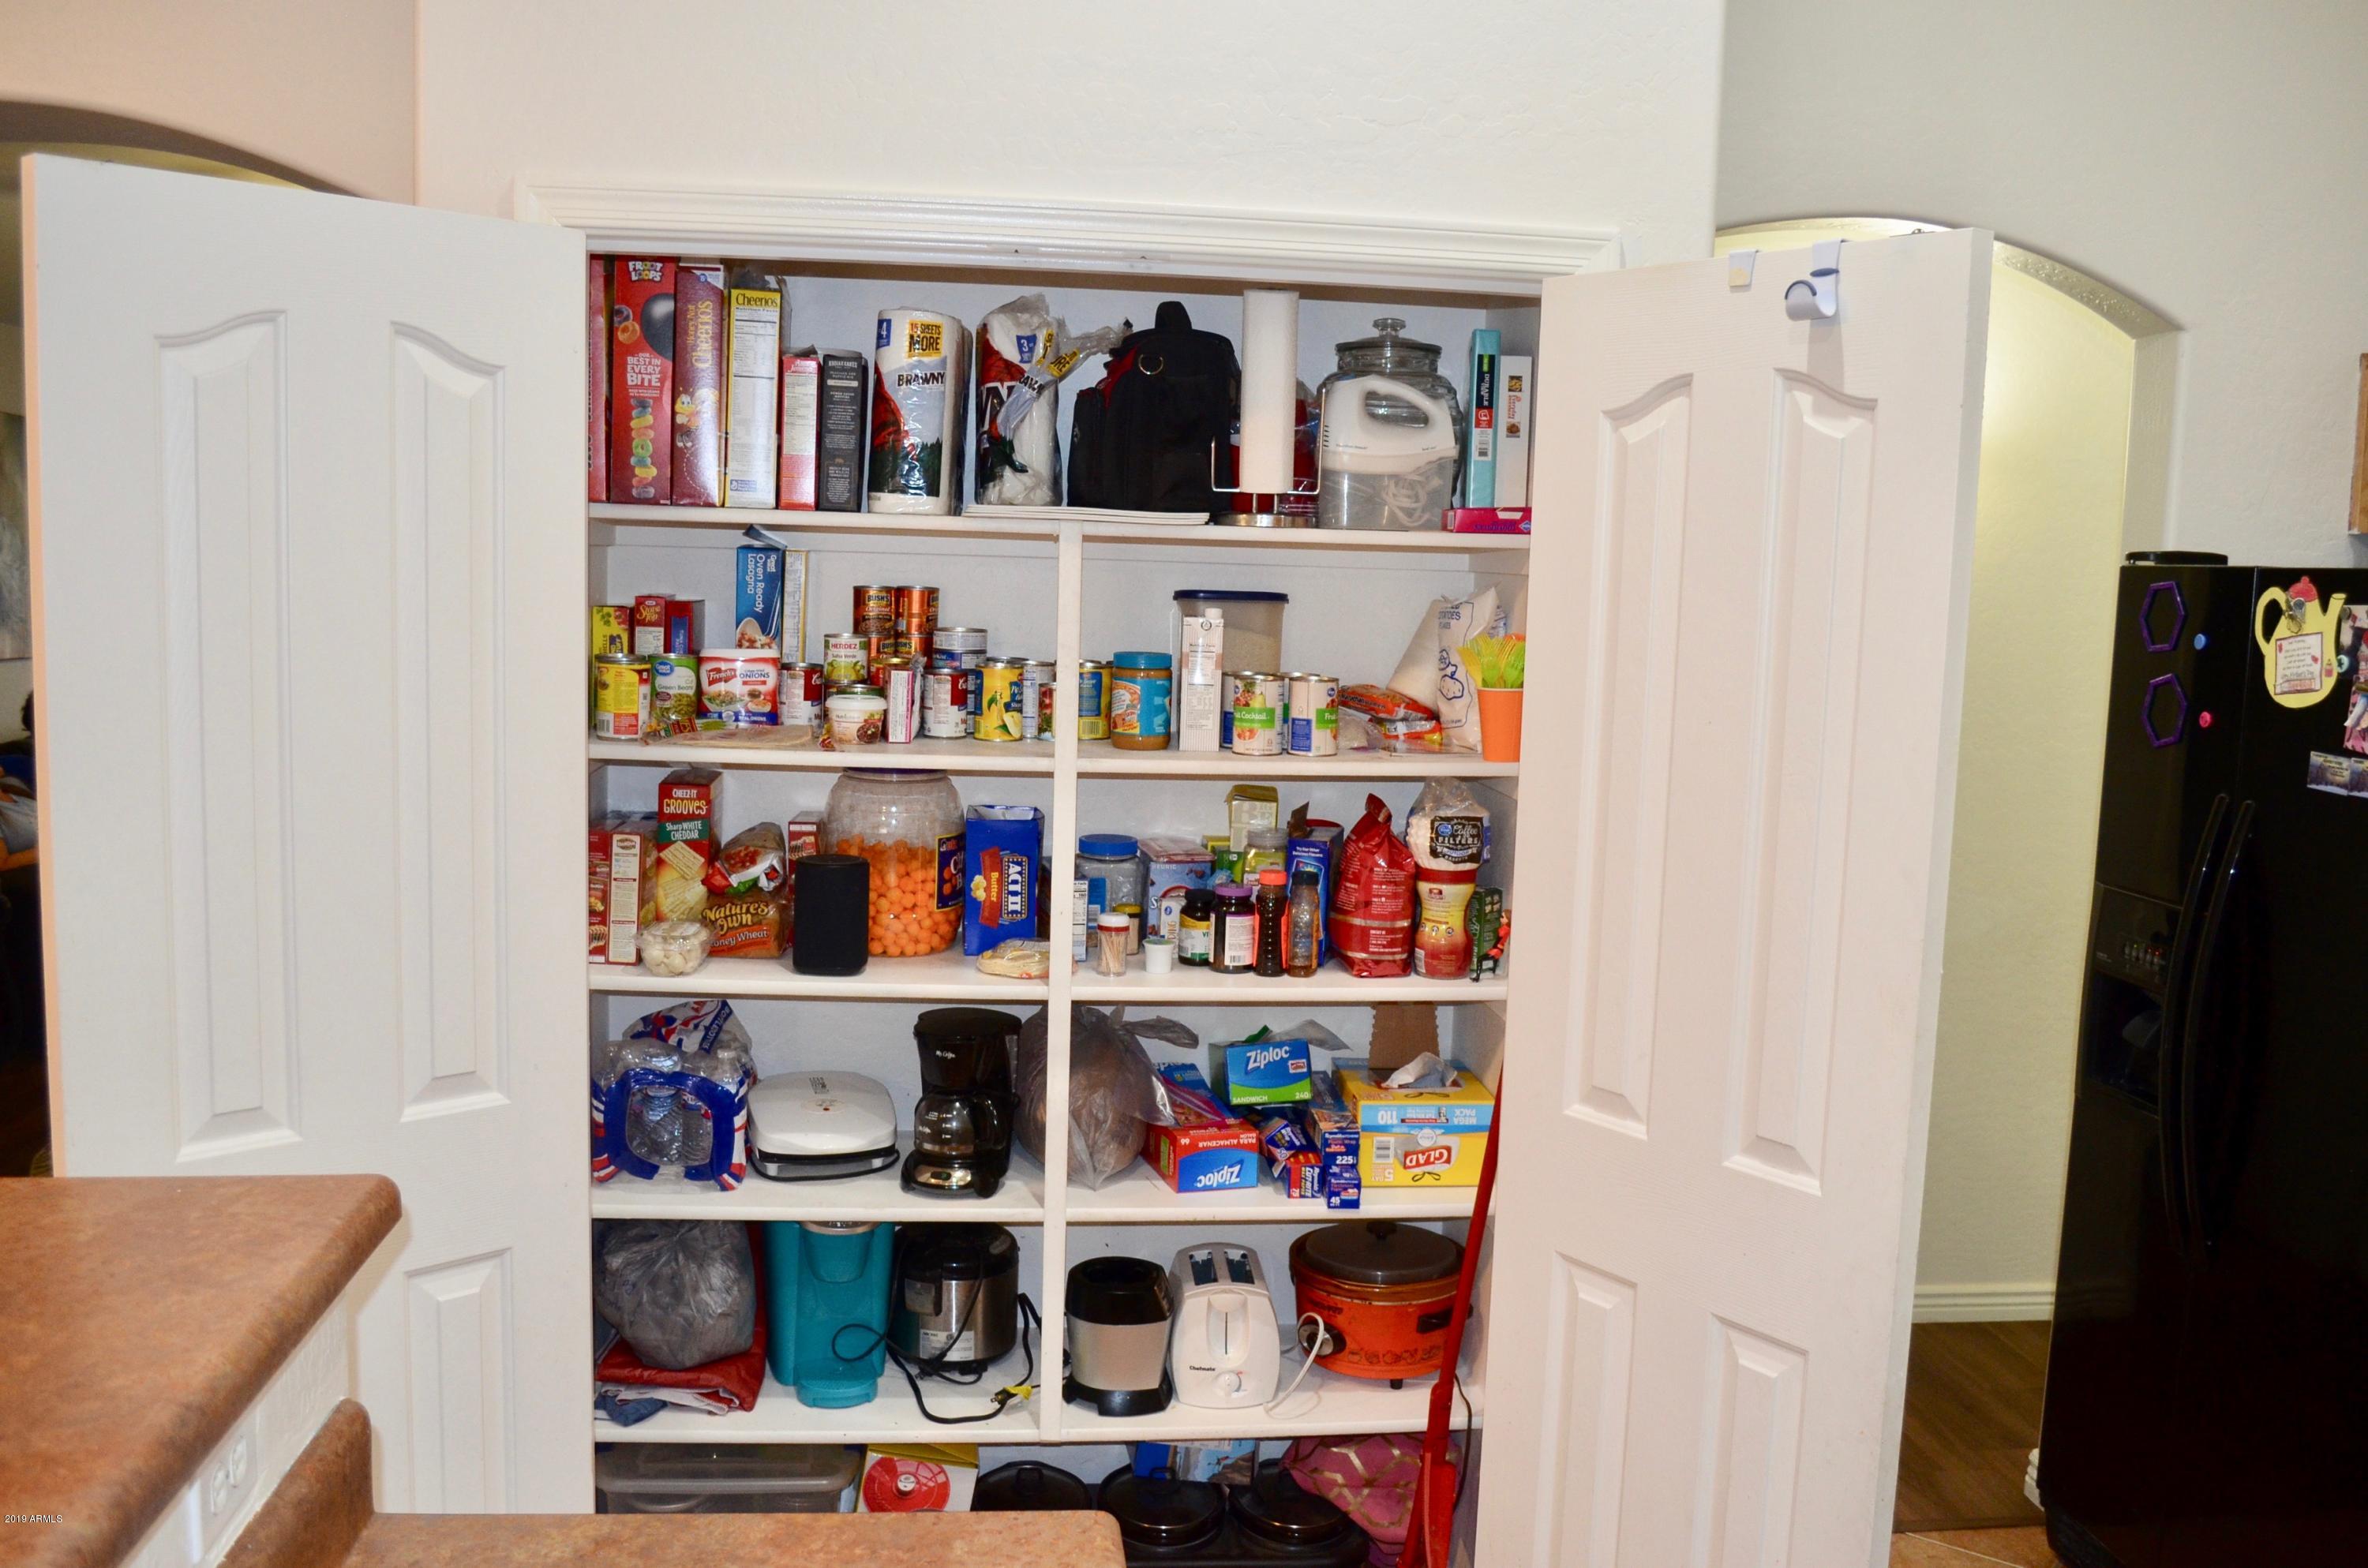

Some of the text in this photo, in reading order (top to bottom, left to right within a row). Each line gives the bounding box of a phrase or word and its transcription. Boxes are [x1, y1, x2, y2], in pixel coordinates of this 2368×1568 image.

[628, 261, 663, 271] FROOT
[631, 271, 662, 282] LOOPS
[736, 293, 777, 307] Cheerios
[691, 299, 714, 369] Cheerios
[910, 323, 942, 335] 15 SHEETS
[909, 334, 941, 352] MORE
[1021, 339, 1029, 352] 3
[628, 357, 650, 365] BEST
[628, 365, 661, 373] EVERY
[628, 373, 661, 386] BITE
[897, 372, 946, 387] BRAWNY
[745, 553, 756, 594] Lasagna
[754, 554, 766, 613] Oven Ready
[709, 670, 736, 680] French's
[665, 821, 703, 831] Sharp WHITE
[1453, 825, 1478, 838] Coffee
[671, 830, 699, 840] CHEDDAR
[991, 872, 999, 902] Butter
[1008, 863, 1022, 911] ACT II
[703, 902, 769, 922] Nature's
[717, 914, 753, 935] Own
[1167, 921, 1177, 940] DING
[737, 930, 767, 941] Wheat
[1246, 1046, 1290, 1070] Ziploc
[1377, 1110, 1398, 1125] 110
[1198, 1139, 1238, 1147] ALMACENAR
[1336, 1155, 1354, 1165] 225
[1405, 1148, 1449, 1166] GLAD
[1196, 1164, 1241, 1188] Ziploc
[1384, 1169, 1393, 1181] 5
[1292, 1188, 1299, 1197] 75
